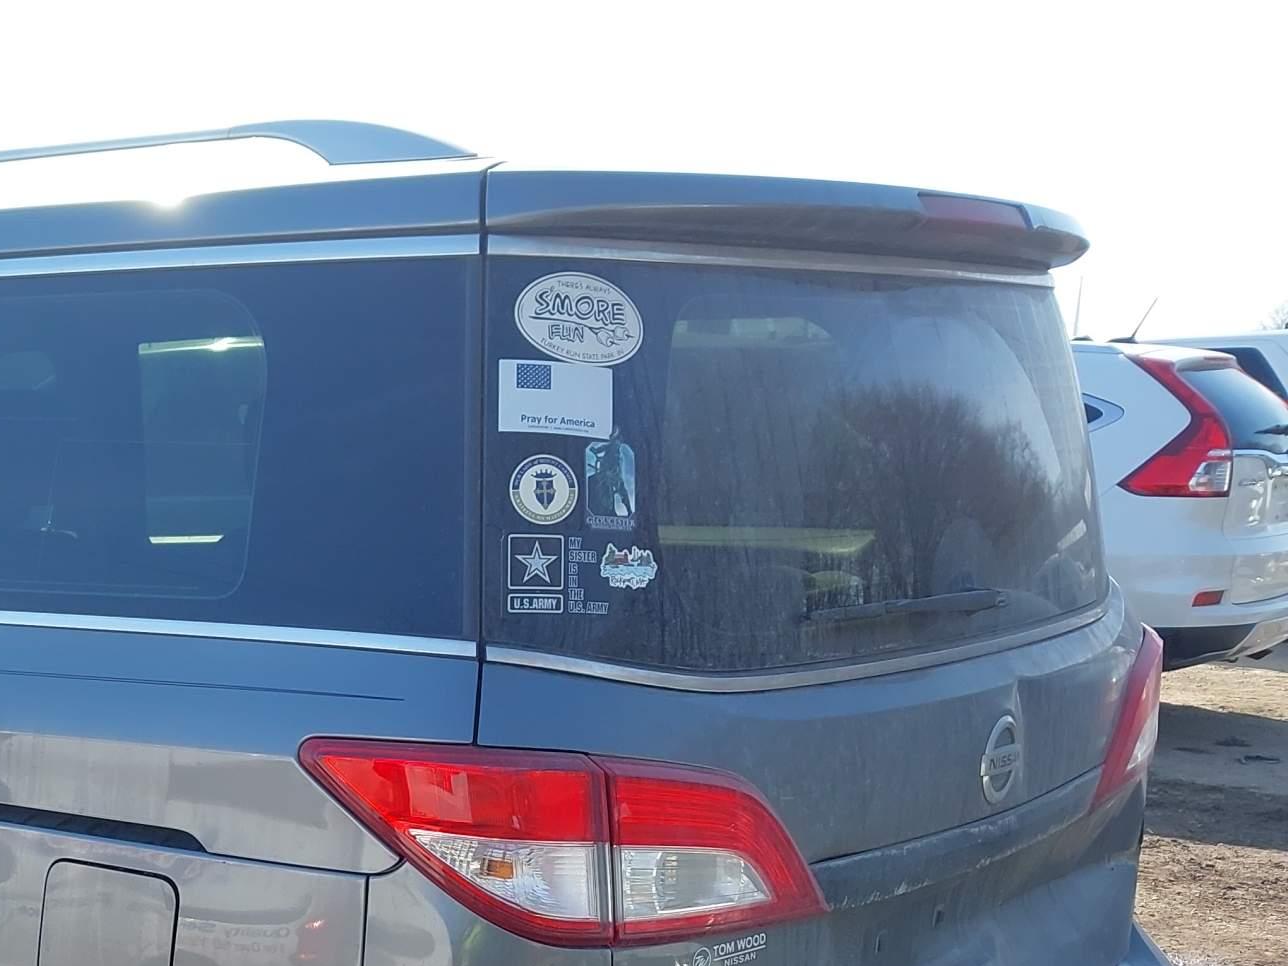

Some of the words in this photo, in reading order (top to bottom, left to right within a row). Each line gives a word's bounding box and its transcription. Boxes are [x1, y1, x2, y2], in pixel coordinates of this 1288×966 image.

[548, 324, 585, 343] FUN
[520, 414, 542, 425] Pray
[544, 415, 558, 424] for
[560, 416, 595, 428] America
[568, 537, 582, 549] MY
[568, 550, 597, 563] SISTER
[568, 563, 578, 575] IS
[568, 576, 578, 587] IN
[568, 588, 584, 600] THE
[568, 601, 585, 613] U.S.
[586, 602, 609, 614] ARMY
[713, 941, 735, 957] TOM
[736, 933, 766, 950] WOOD
[724, 952, 756, 966] NISSAN
